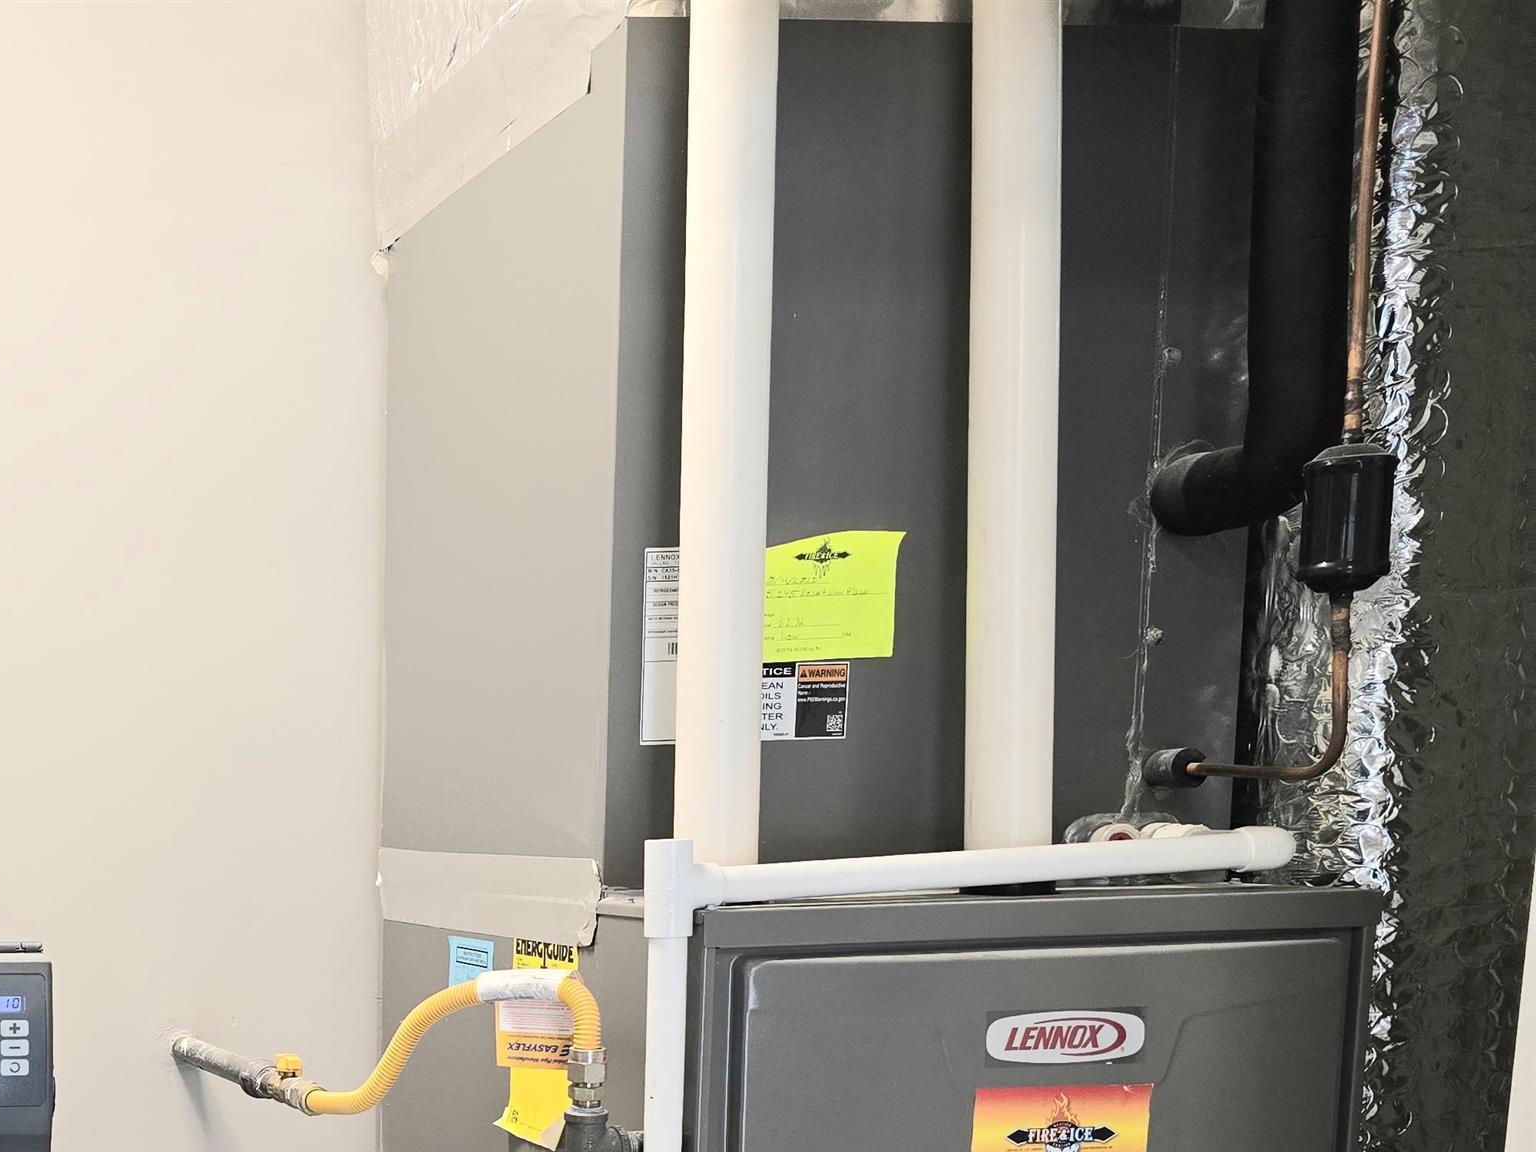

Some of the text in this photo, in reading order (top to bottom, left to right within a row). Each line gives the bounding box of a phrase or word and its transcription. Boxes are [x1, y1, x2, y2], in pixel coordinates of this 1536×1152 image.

[808, 669, 845, 678] WARNING
[1004, 1024, 1105, 1051] LENNOX
[508, 1043, 559, 1053] EASYFLEX
[1028, 1127, 1094, 1143] FIRE & ICE
